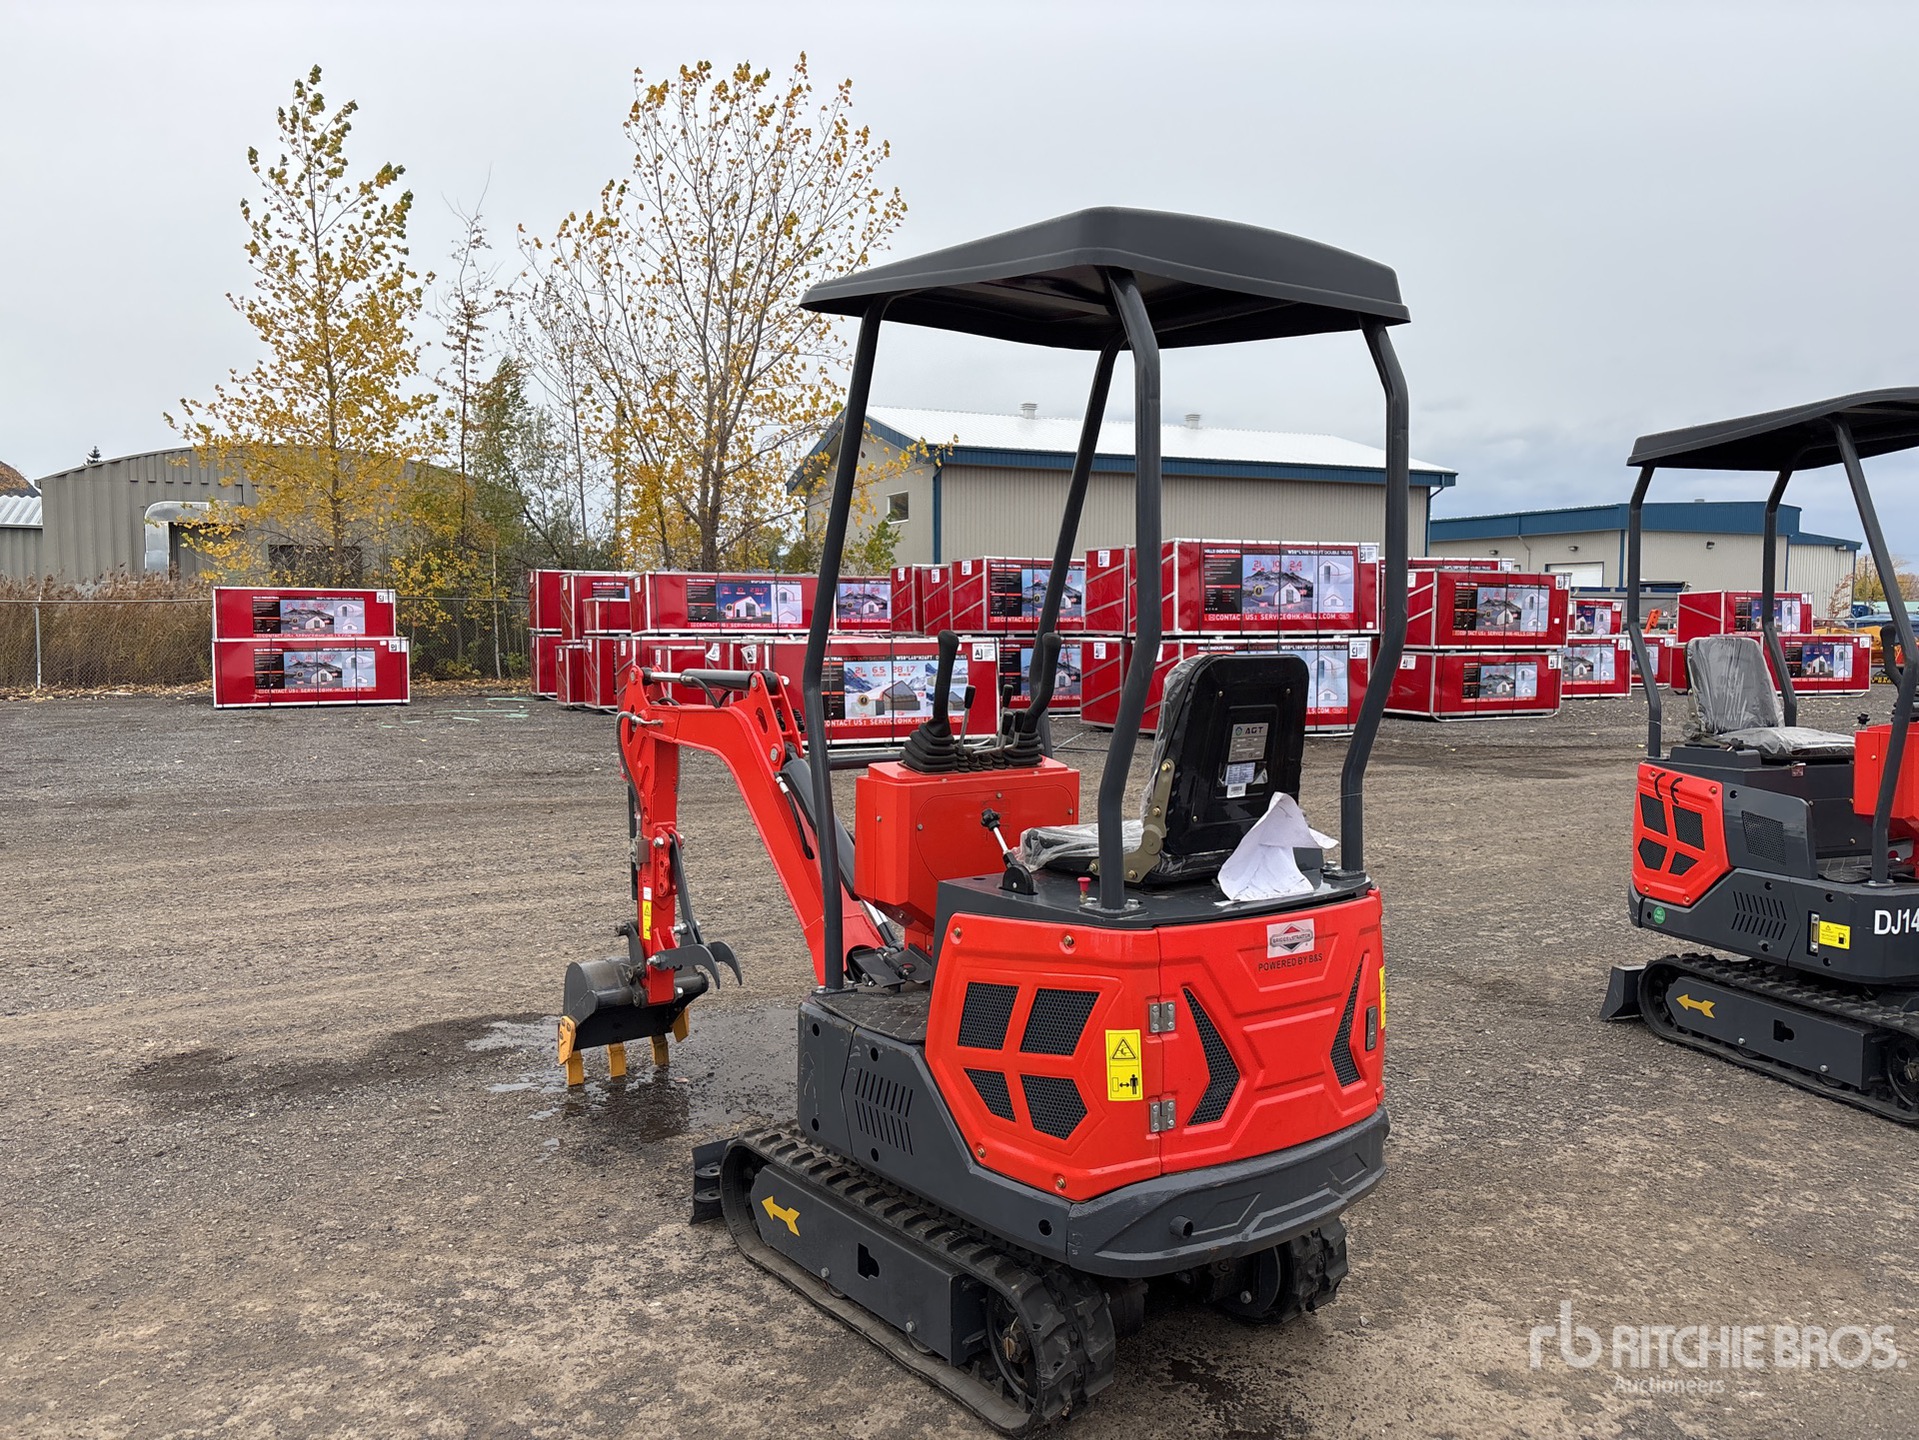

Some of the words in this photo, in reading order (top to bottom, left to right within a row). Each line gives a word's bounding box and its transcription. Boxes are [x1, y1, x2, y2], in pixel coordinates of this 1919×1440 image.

[1215, 613, 1243, 621] CONTAC
[1260, 612, 1336, 620] SERVICE@HK-HILL.COM
[1244, 726, 1264, 735] AGT
[1258, 957, 1297, 972] POWERED
[1297, 955, 1307, 966] BY
[1308, 952, 1323, 964] B&S
